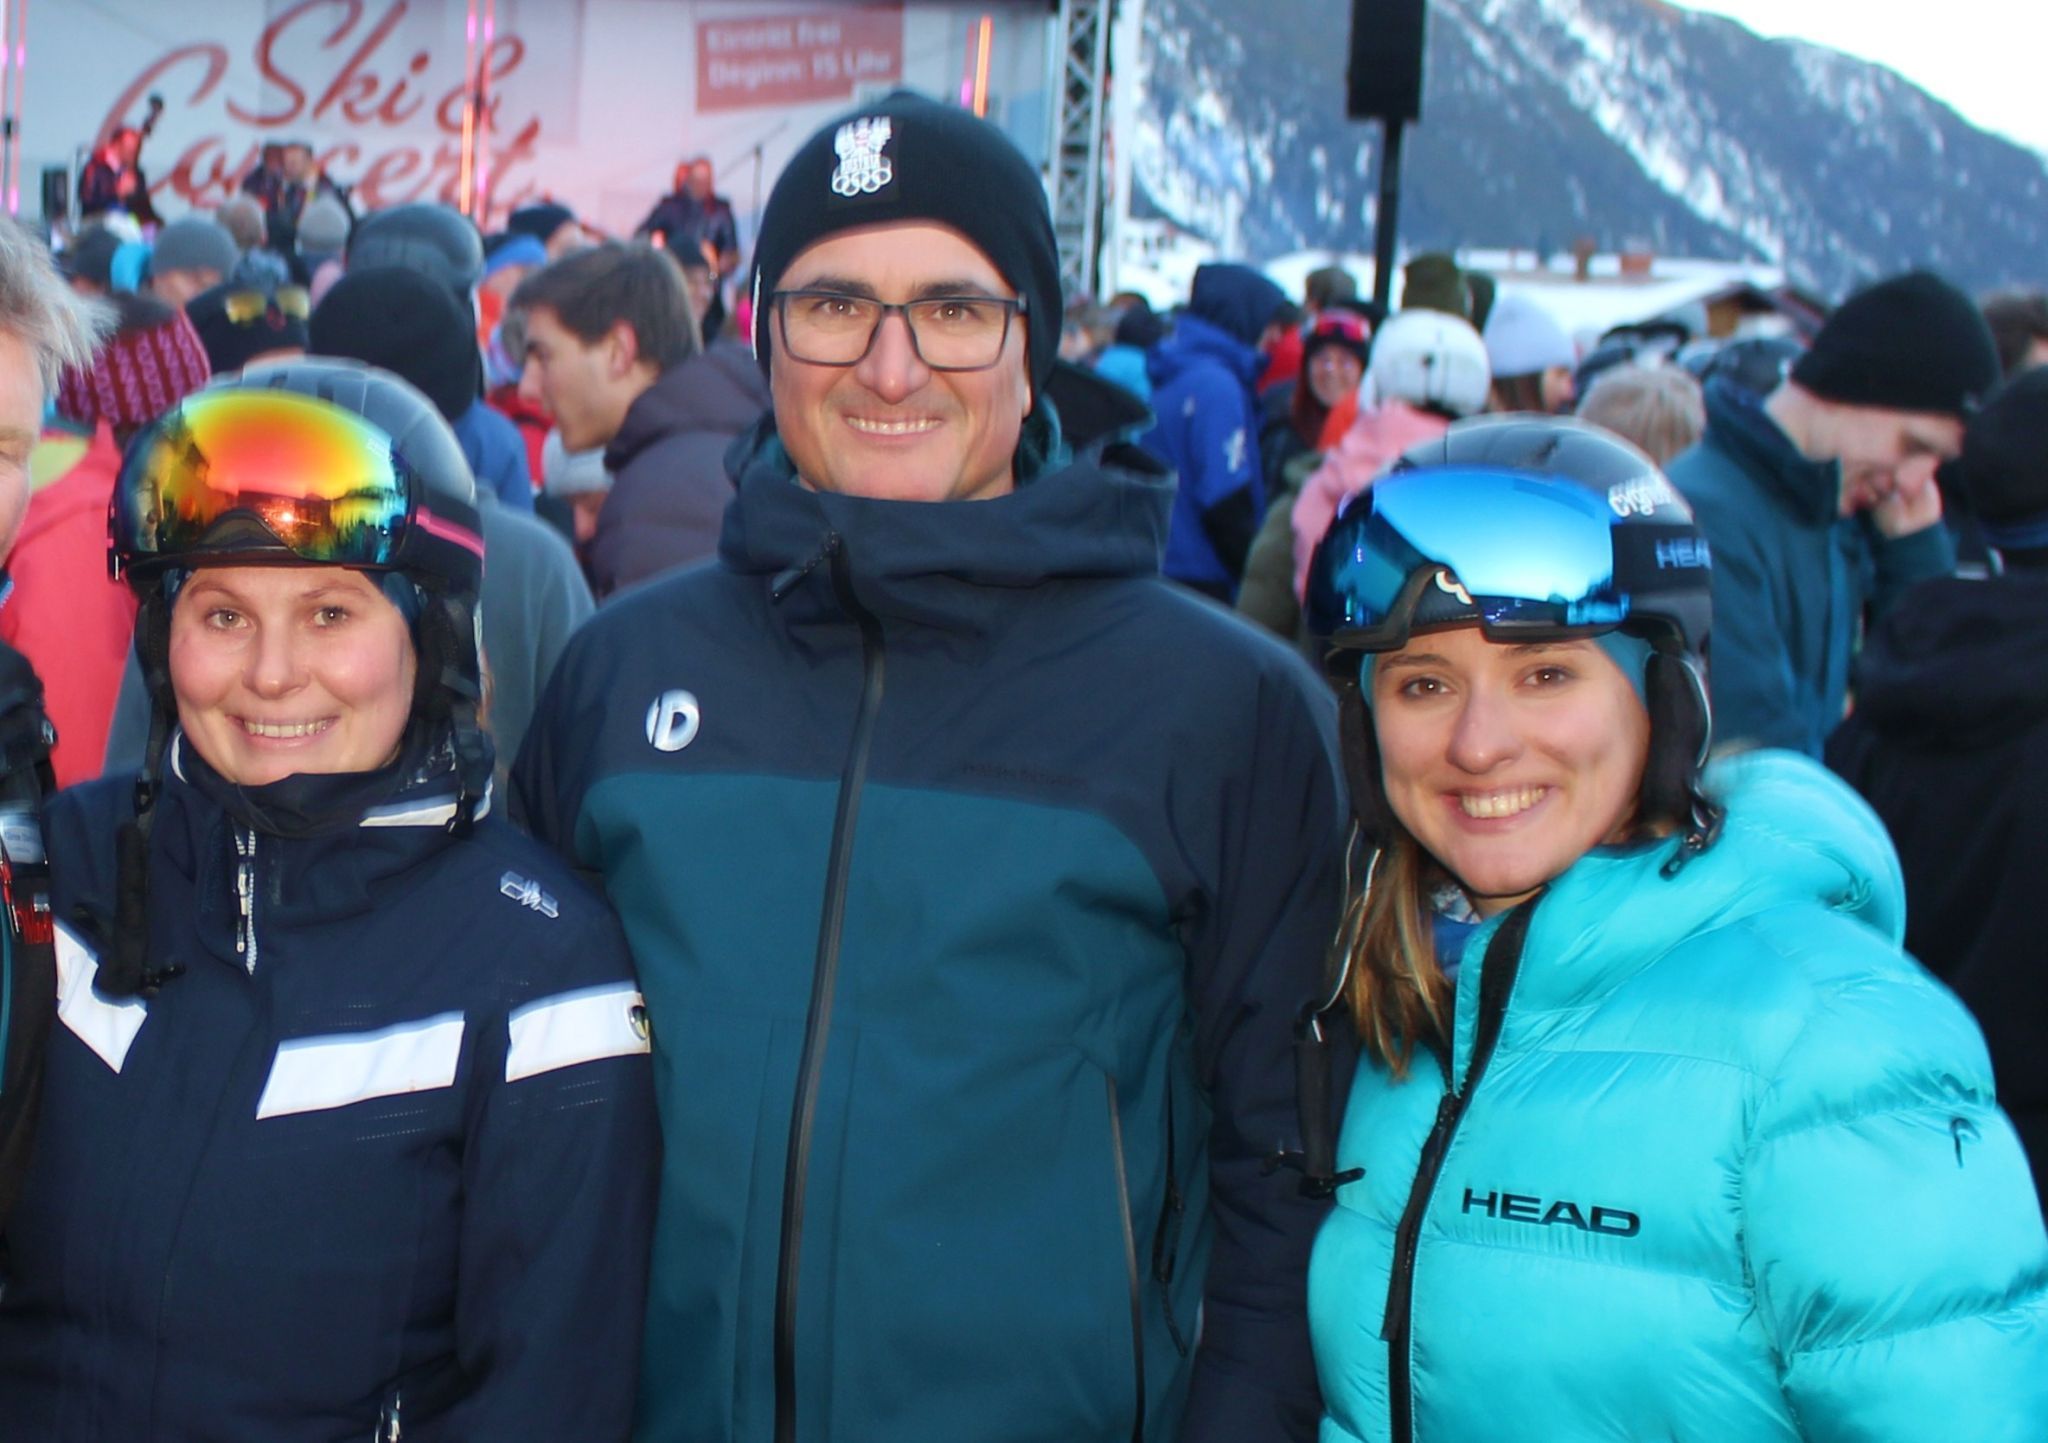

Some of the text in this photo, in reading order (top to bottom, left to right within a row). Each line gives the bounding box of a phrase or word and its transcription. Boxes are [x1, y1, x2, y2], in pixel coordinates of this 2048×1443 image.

[227, 0, 525, 133] Ski &
[1462, 1187, 1641, 1238] HEAD
